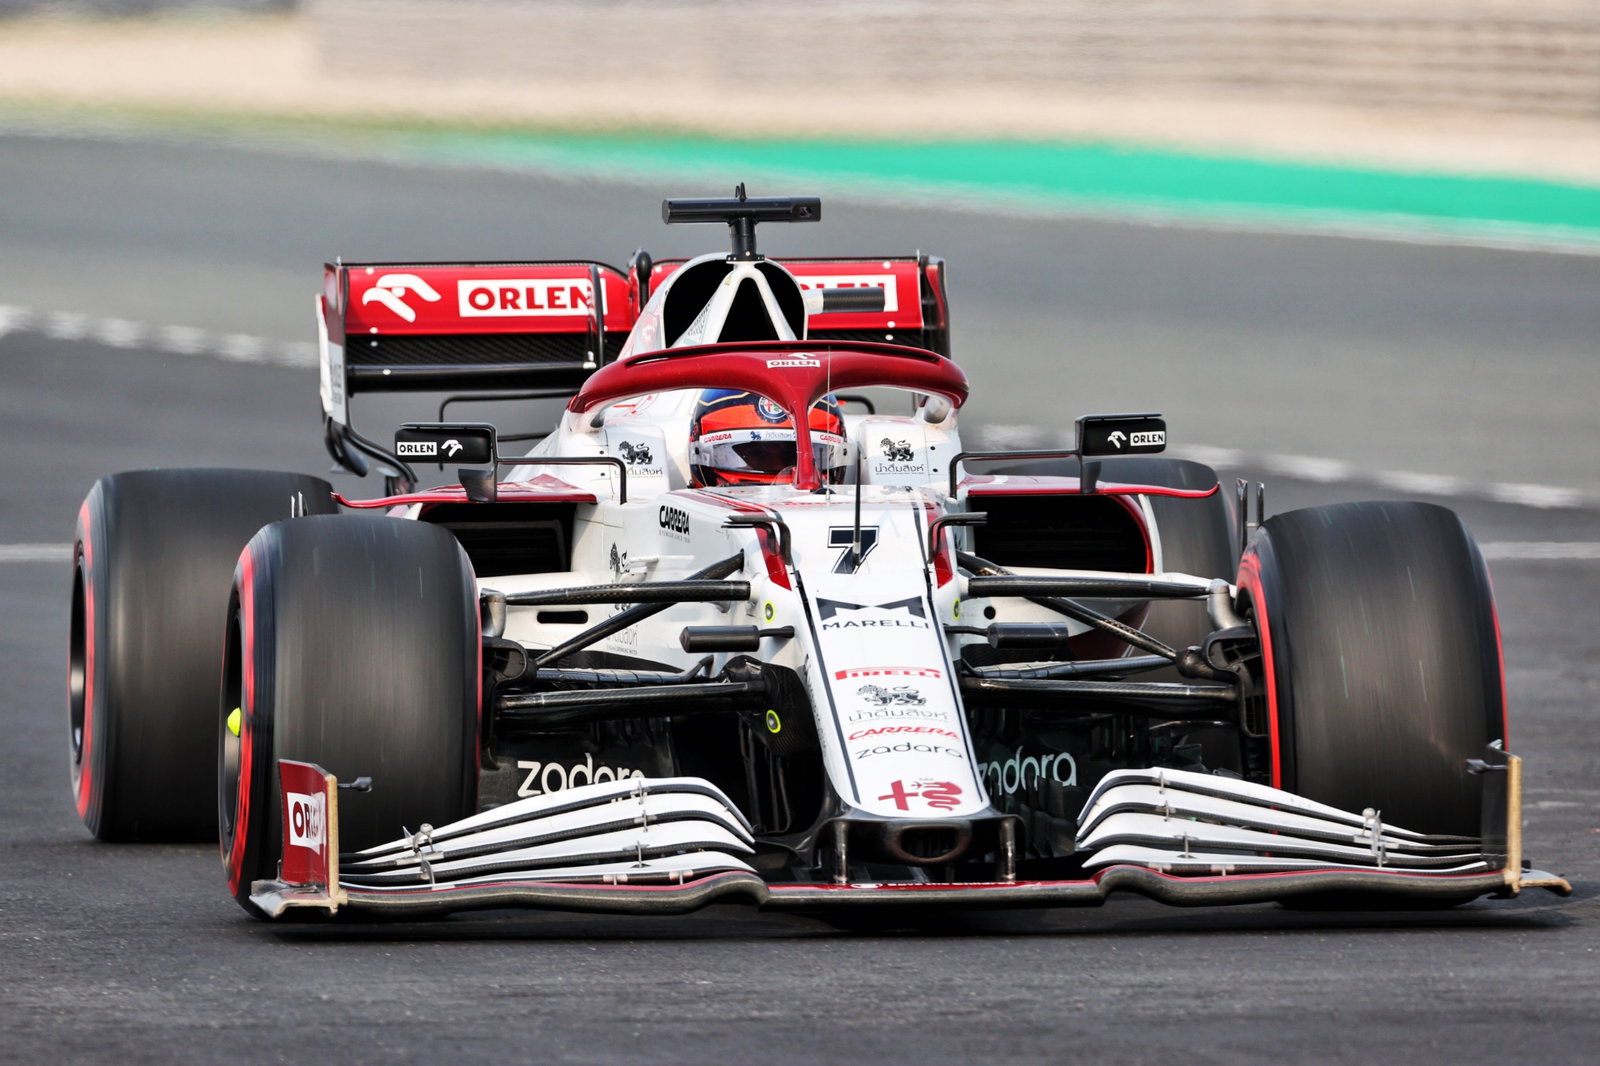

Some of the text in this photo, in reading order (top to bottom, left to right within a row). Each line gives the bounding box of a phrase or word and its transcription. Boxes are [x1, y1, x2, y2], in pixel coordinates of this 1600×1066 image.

[468, 285, 594, 311] ORLEN
[703, 433, 732, 443] CARRERA
[1132, 433, 1164, 444] ORLEN
[399, 444, 434, 453] ORLEN
[659, 505, 690, 536] CARRERA
[827, 525, 880, 575] 7
[822, 619, 929, 631] MARELLI
[848, 726, 959, 740] CARRERA
[856, 742, 963, 760] zadara
